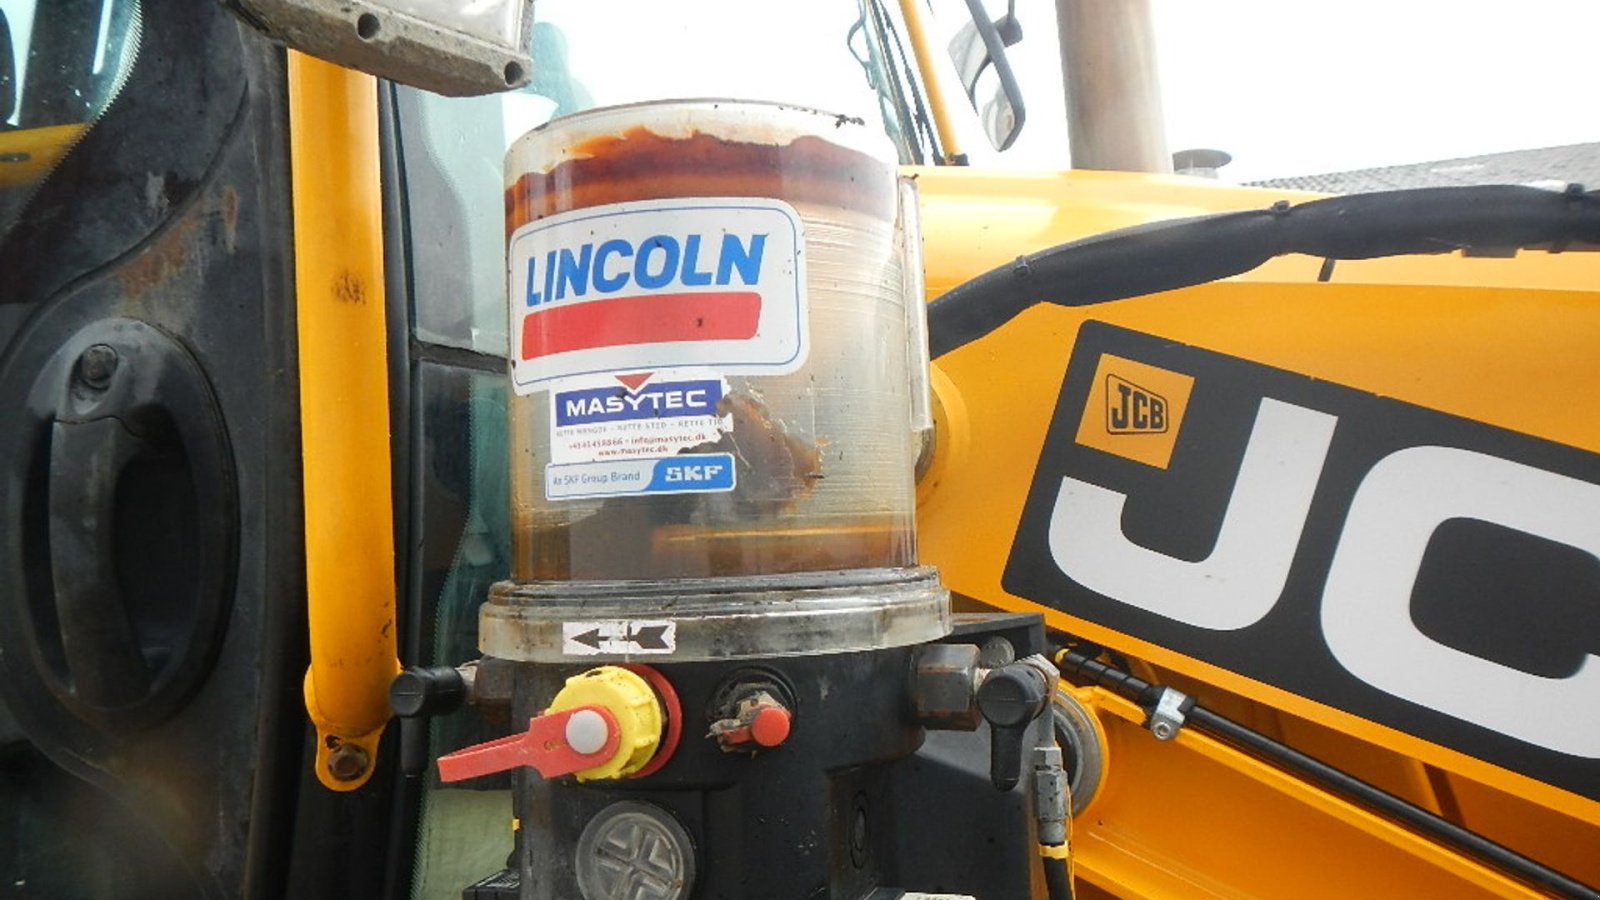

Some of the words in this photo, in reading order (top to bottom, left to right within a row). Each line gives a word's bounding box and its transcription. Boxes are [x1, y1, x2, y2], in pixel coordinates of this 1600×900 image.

[526, 233, 768, 307] LINCOLN
[566, 389, 707, 417] MASYTEC
[1111, 383, 1164, 429] JCB
[564, 474, 580, 485] SKF
[581, 472, 608, 484] Group
[611, 471, 640, 481] Brand
[665, 465, 723, 483] SKF
[1048, 396, 1600, 760] JC
